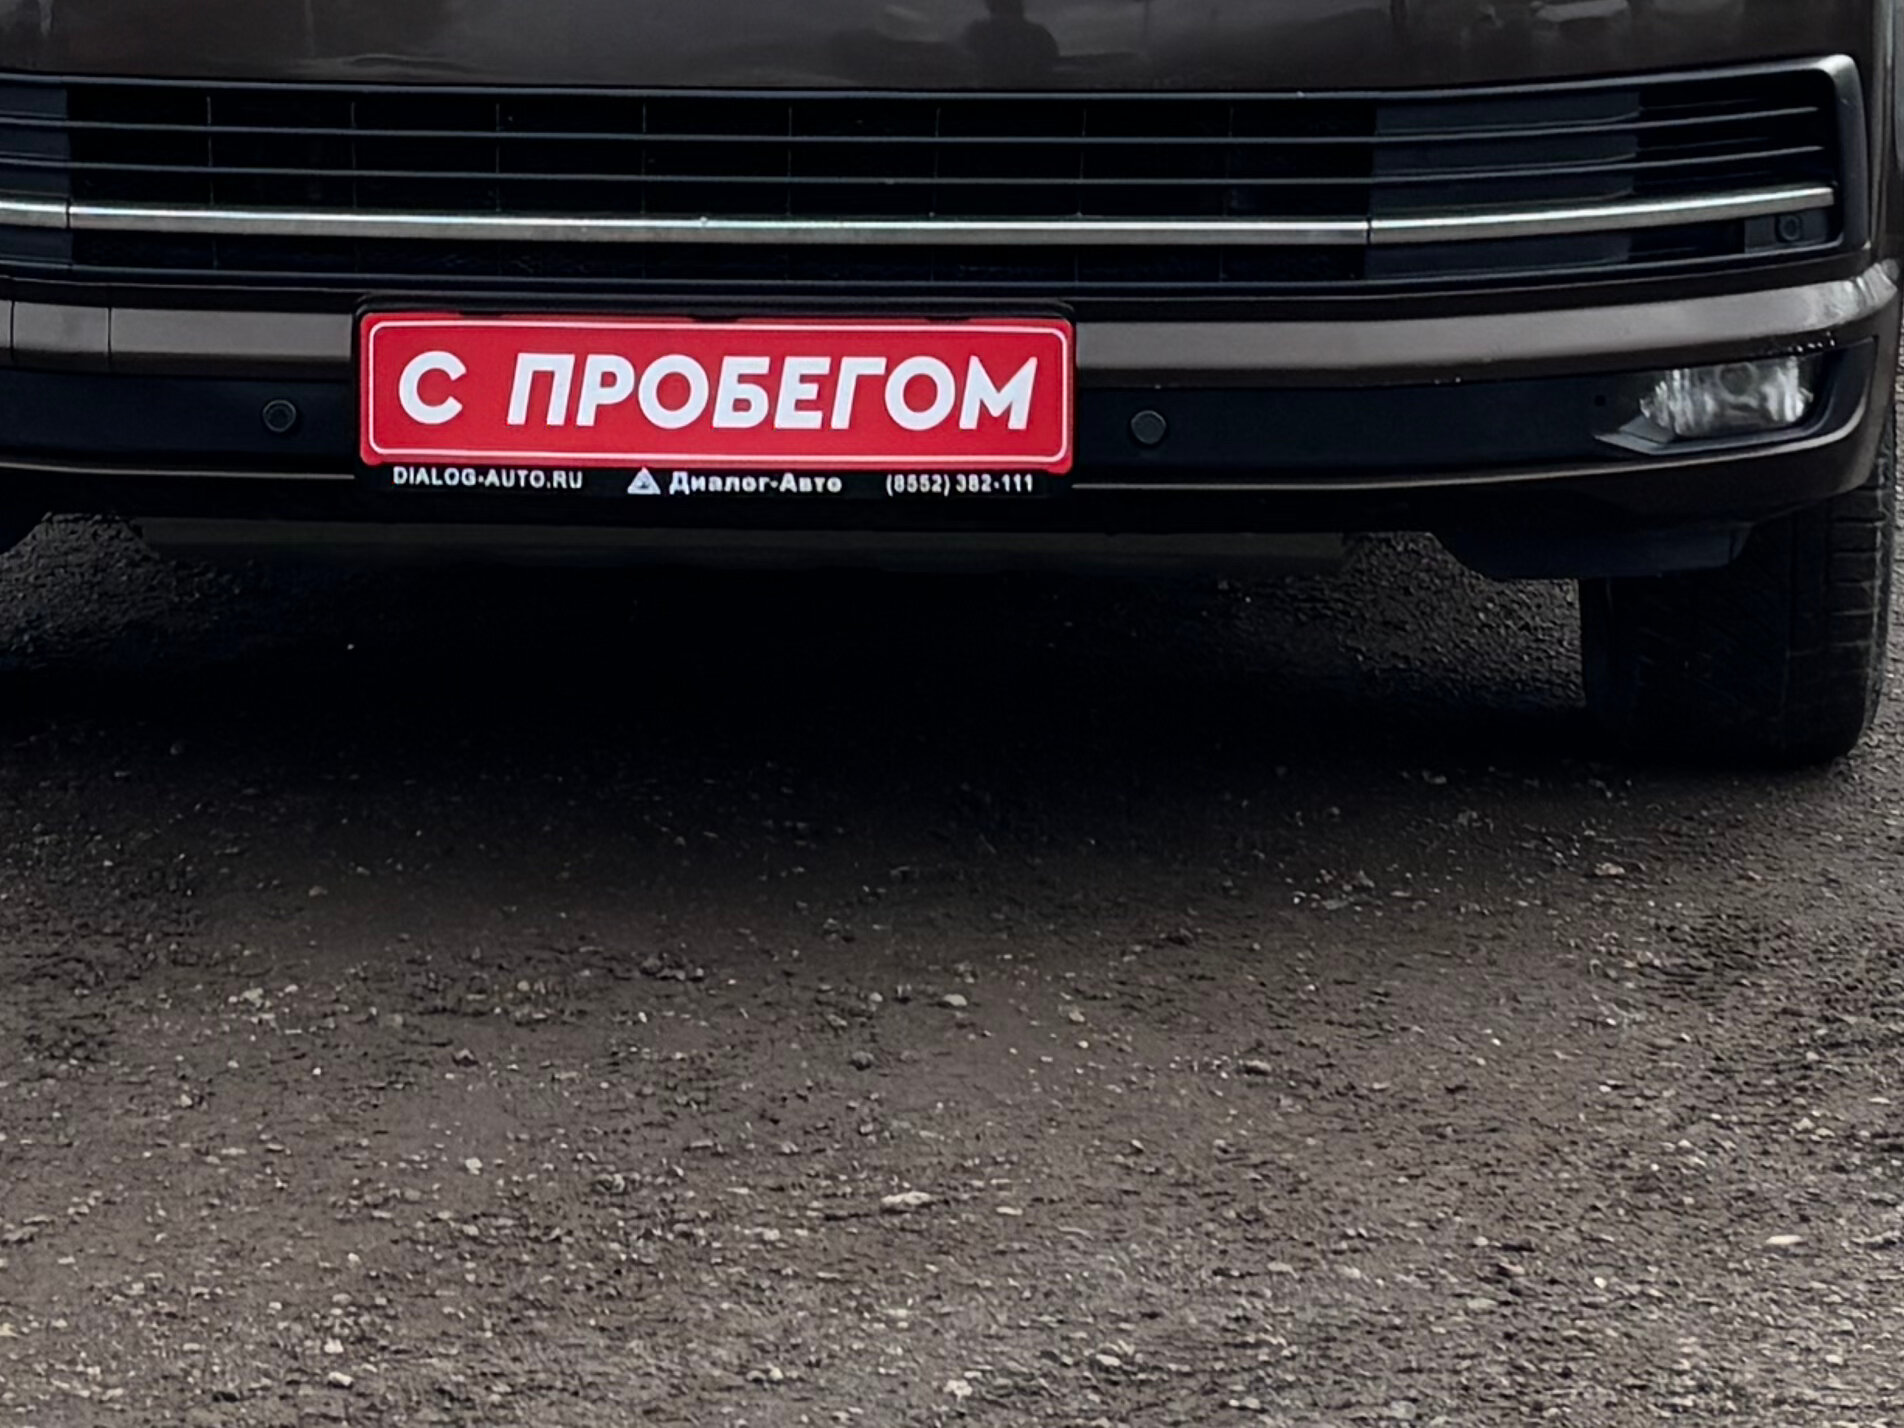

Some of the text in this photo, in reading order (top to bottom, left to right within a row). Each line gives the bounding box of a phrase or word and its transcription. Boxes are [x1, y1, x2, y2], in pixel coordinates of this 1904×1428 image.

[398, 349, 1039, 433] С ПРОБЕГОМ
[392, 466, 584, 489] DIALOG-AUTO.RU
[669, 471, 843, 495] Диалог-Авто
[885, 474, 1034, 497] (8552) 382-111
